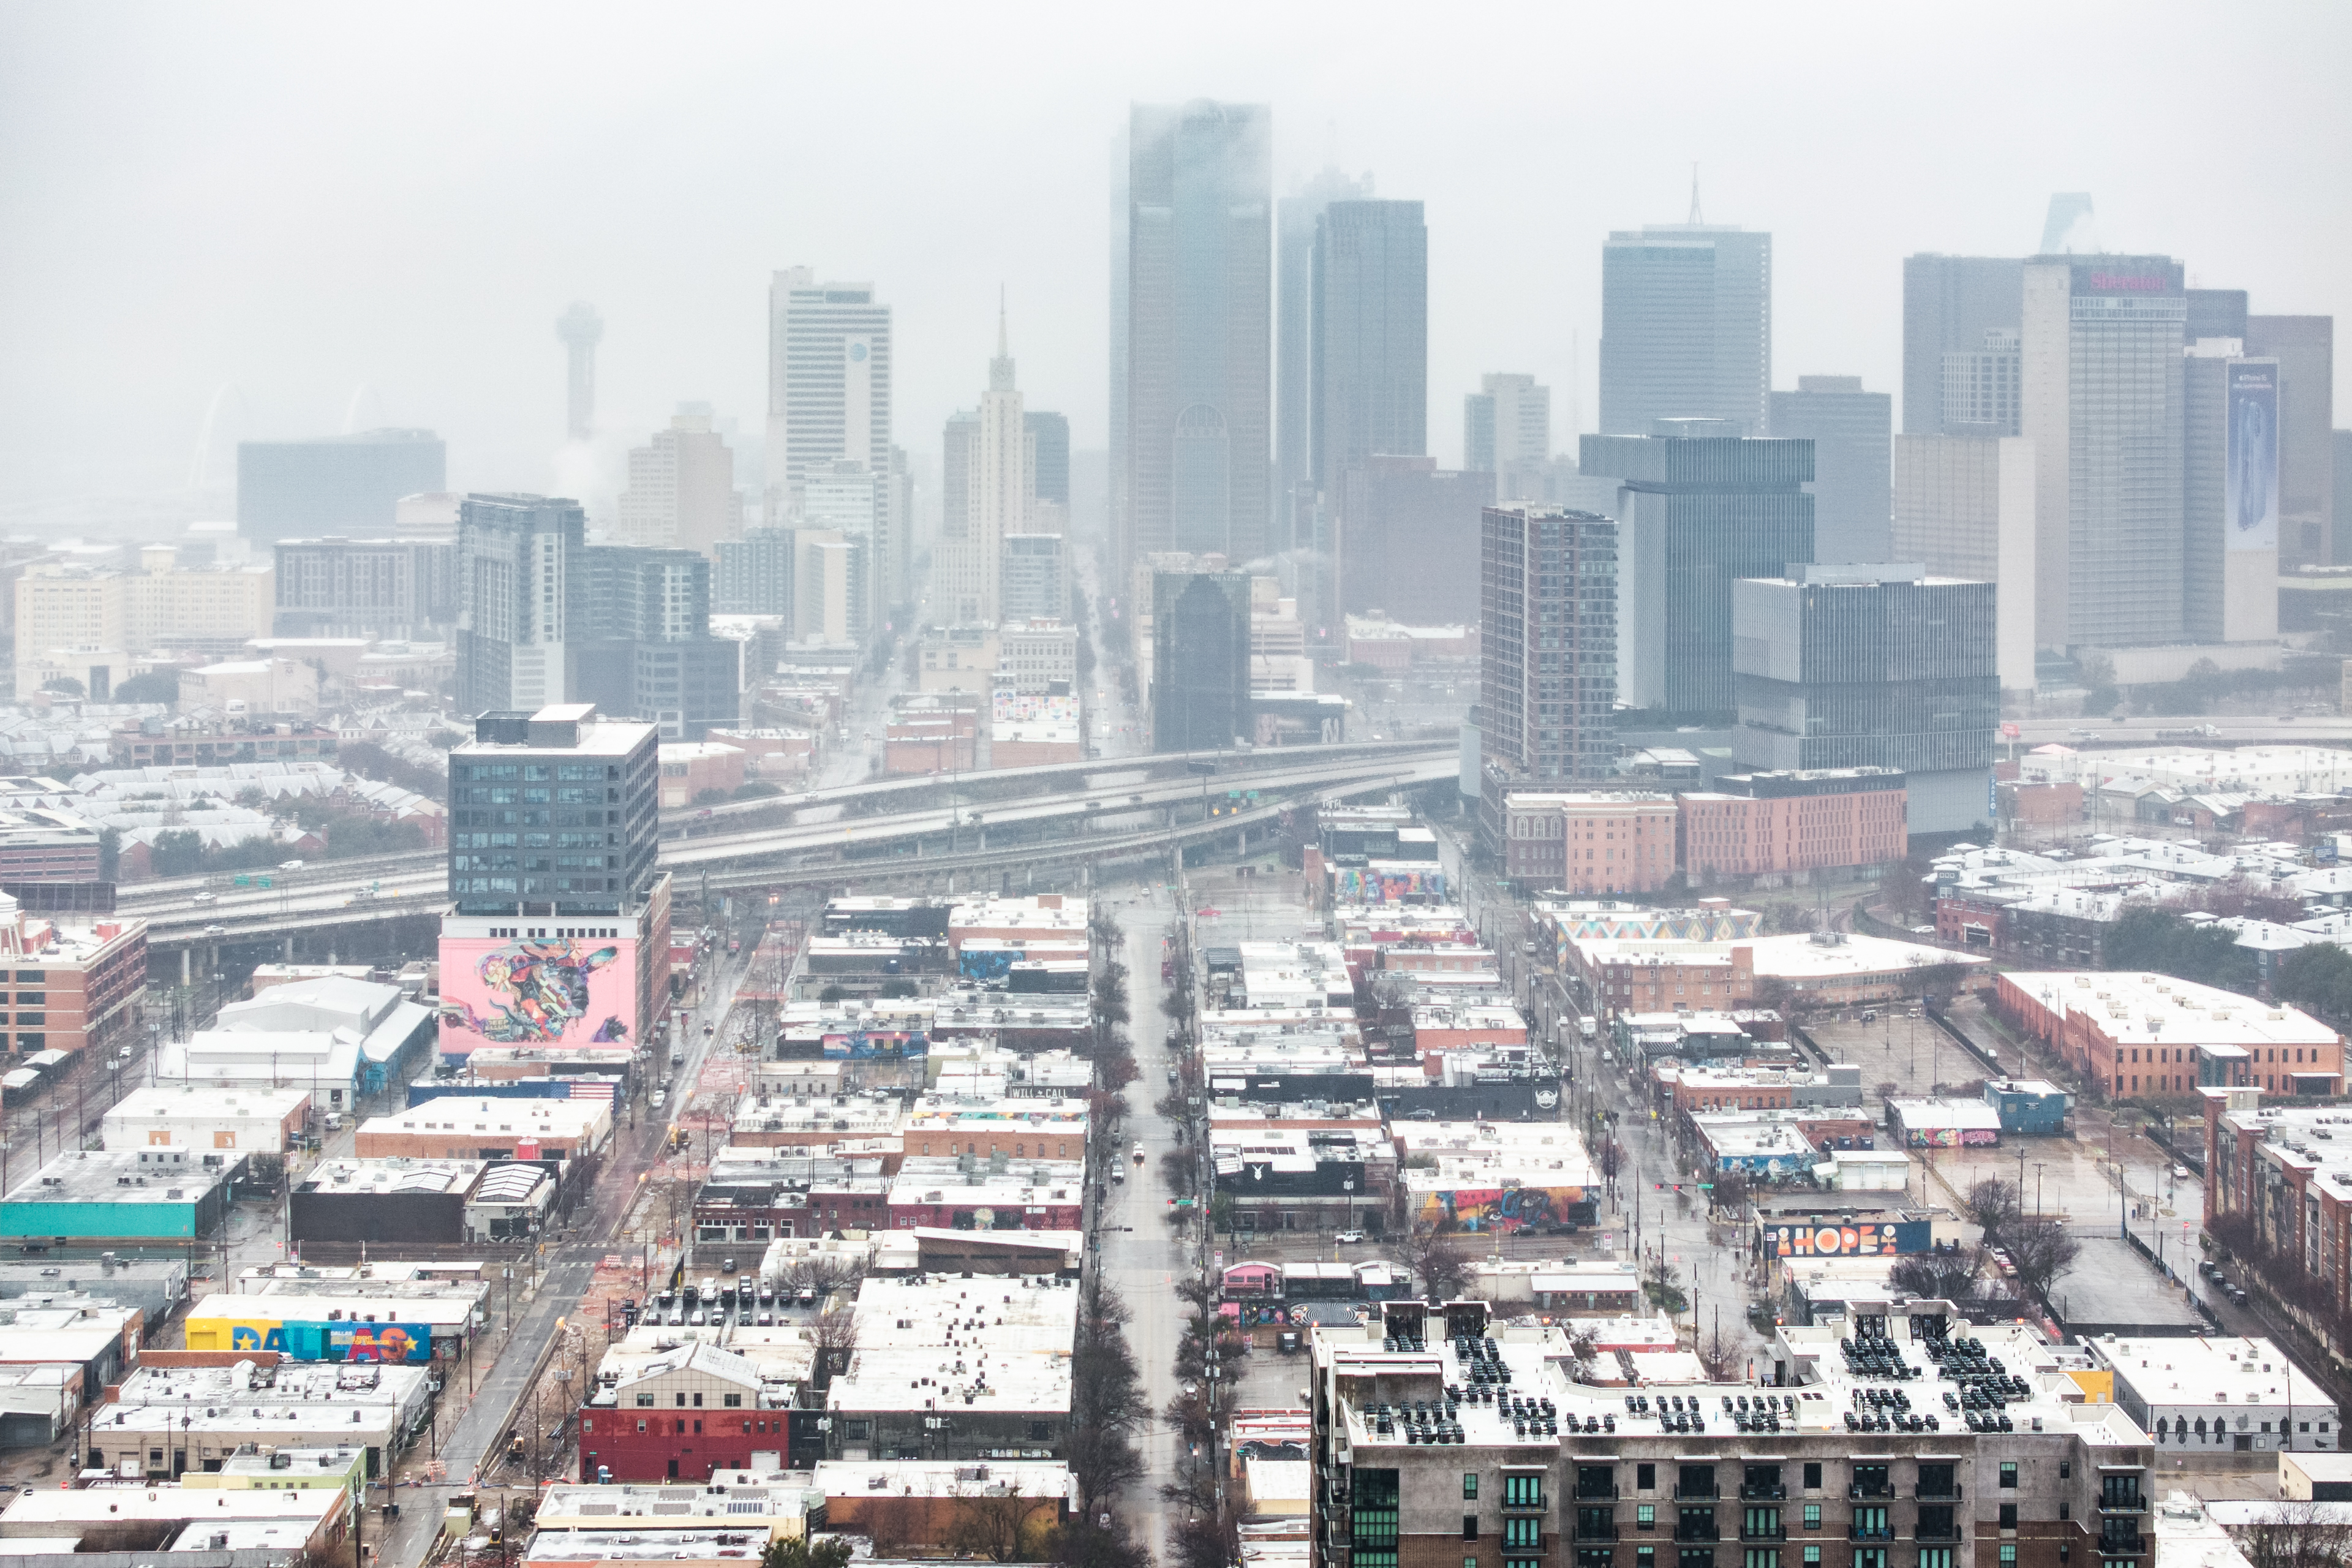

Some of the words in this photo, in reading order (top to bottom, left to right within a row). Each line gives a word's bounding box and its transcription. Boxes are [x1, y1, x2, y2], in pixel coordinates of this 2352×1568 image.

[1012, 1088, 1034, 1098] WILL
[1046, 1088, 1068, 1098] CALL
[1793, 1226, 1878, 1254] HOPE
[232, 1326, 409, 1360] DALLAS
